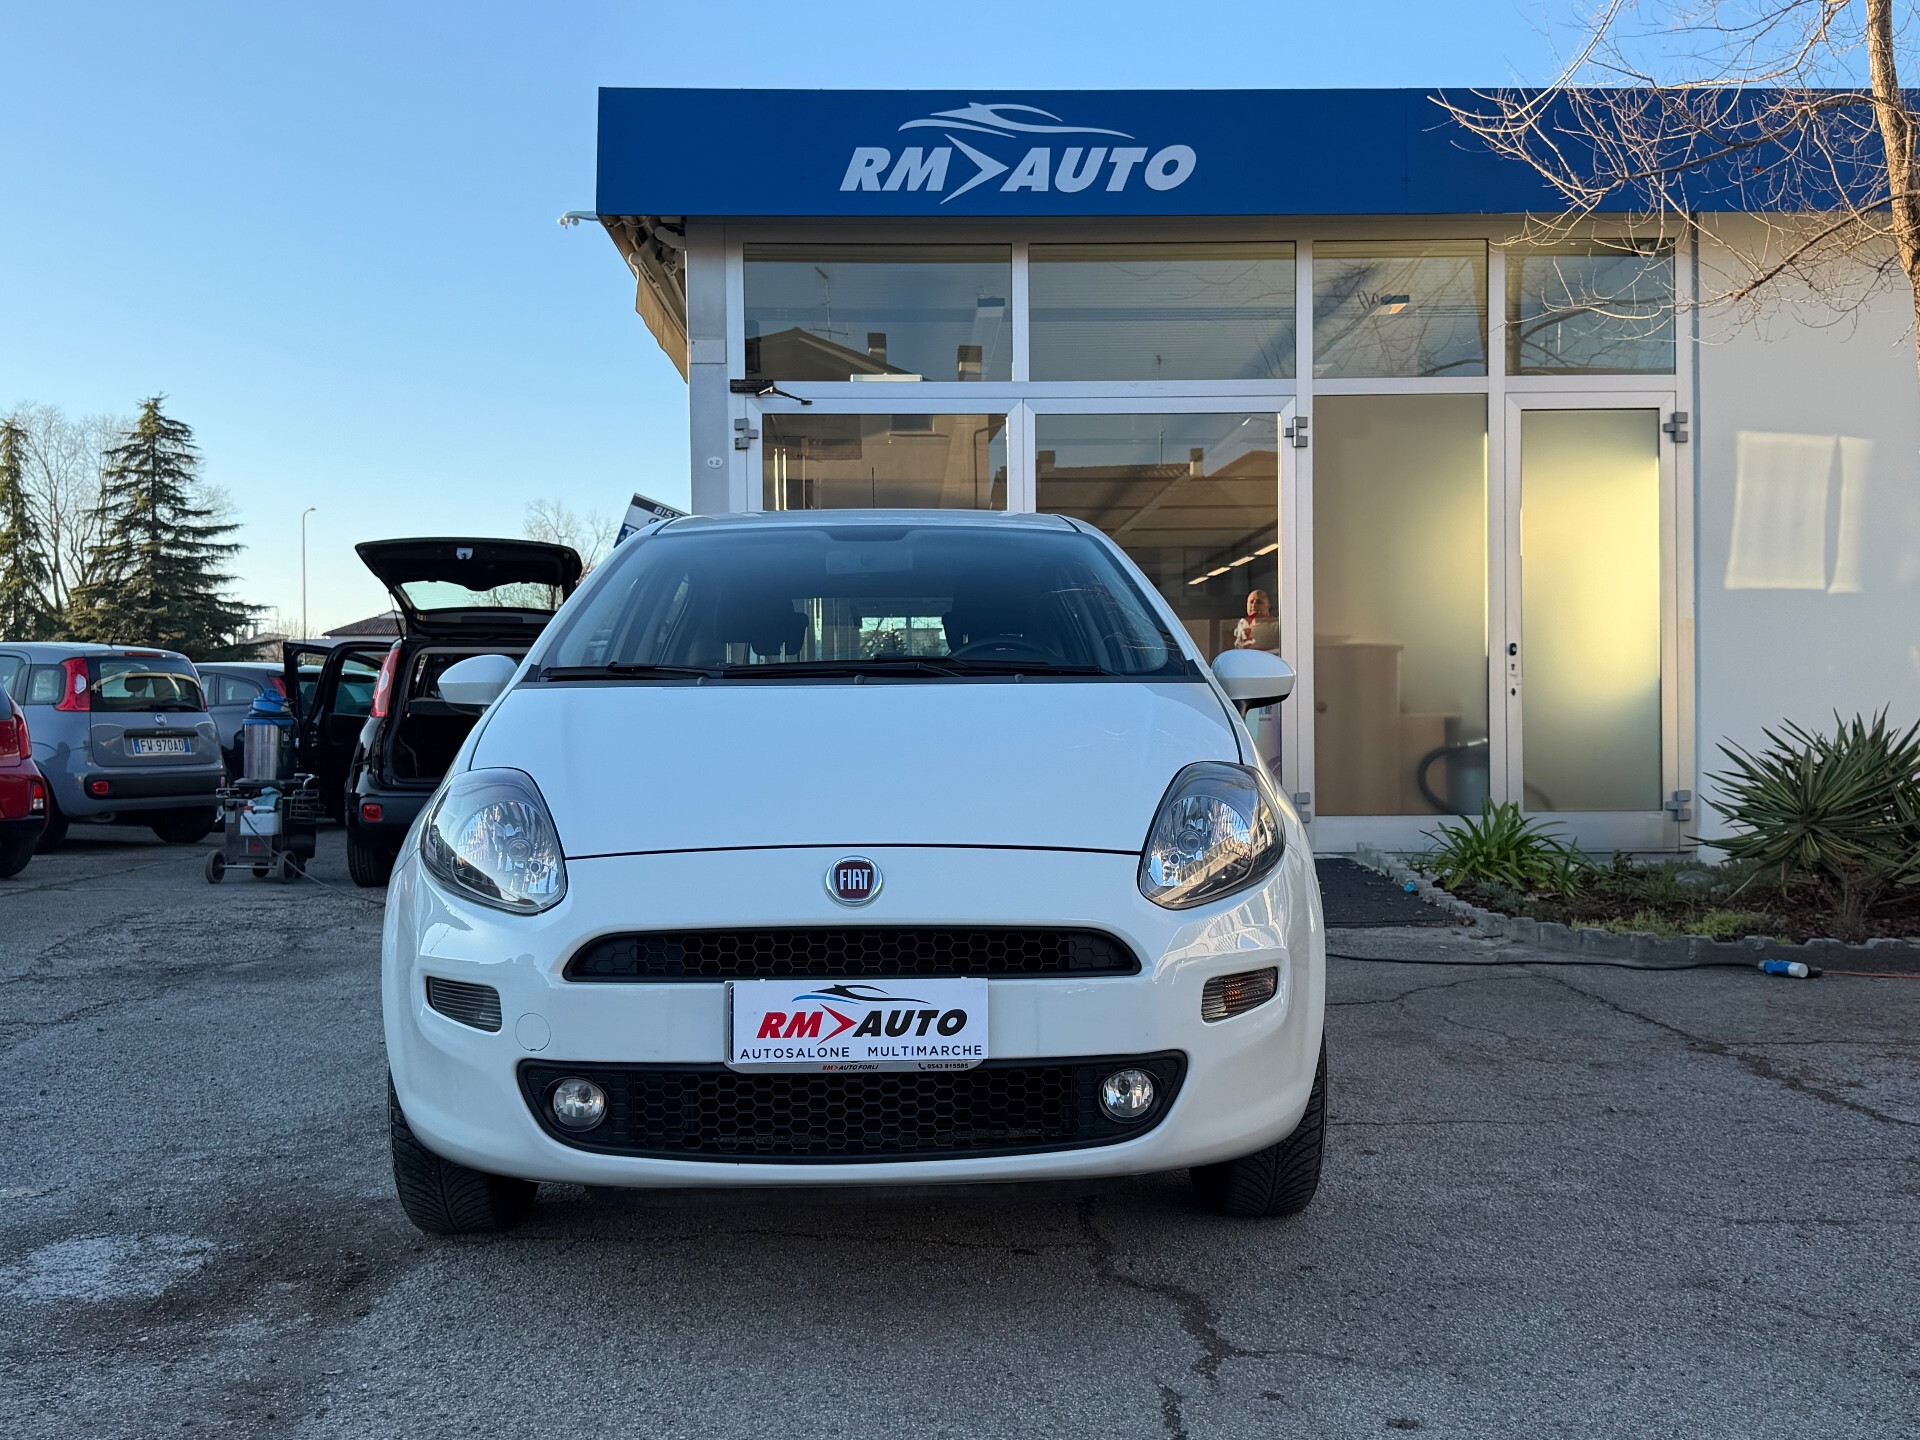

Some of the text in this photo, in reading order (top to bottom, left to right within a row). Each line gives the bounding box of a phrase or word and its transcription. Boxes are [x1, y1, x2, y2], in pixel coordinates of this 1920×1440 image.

[1000, 144, 1197, 193] AUTO
[840, 869, 871, 890] FIAT
[852, 1008, 968, 1038] AUTO
[740, 1045, 982, 1060] AUTOSALONE MULTIMARCHE
